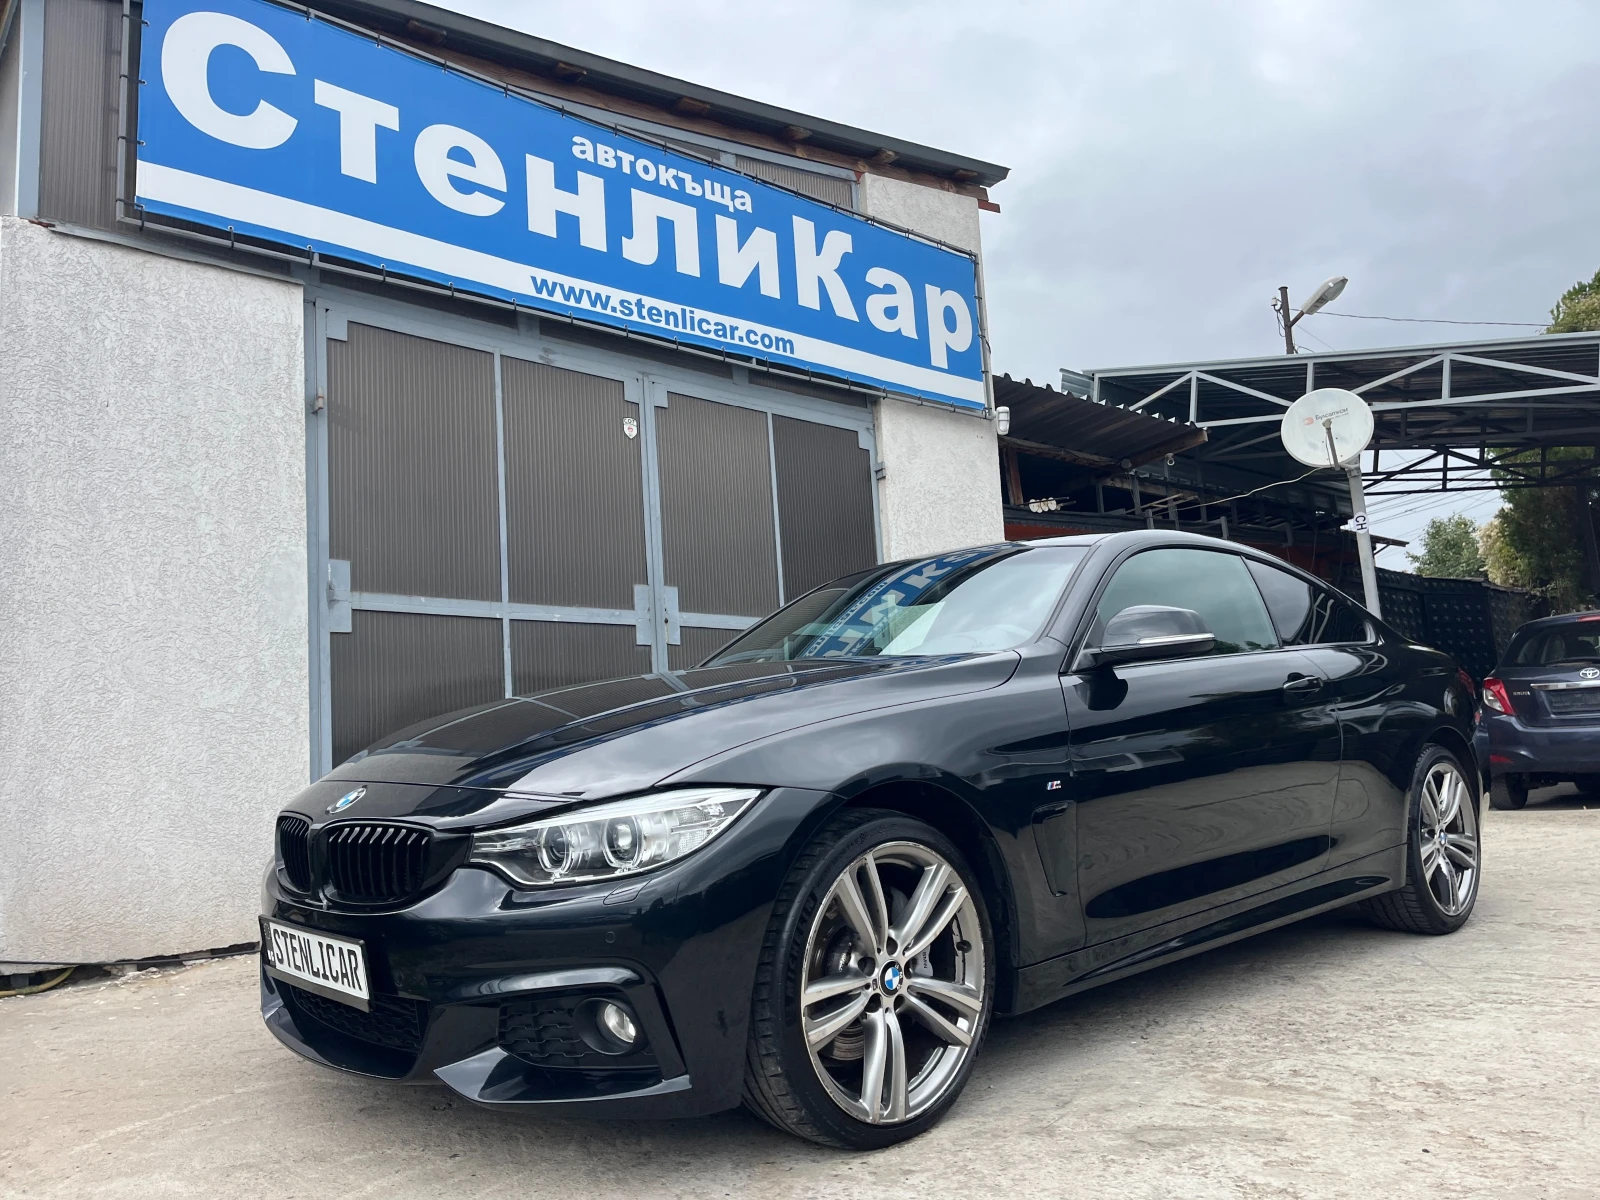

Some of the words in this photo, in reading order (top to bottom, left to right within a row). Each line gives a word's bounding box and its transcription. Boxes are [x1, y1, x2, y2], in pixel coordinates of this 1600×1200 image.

[161, 11, 973, 370] СтенлиКар
[571, 135, 753, 214] автокъща
[530, 274, 795, 356] www.stenlicar.com
[272, 928, 363, 992] STENLICAR
